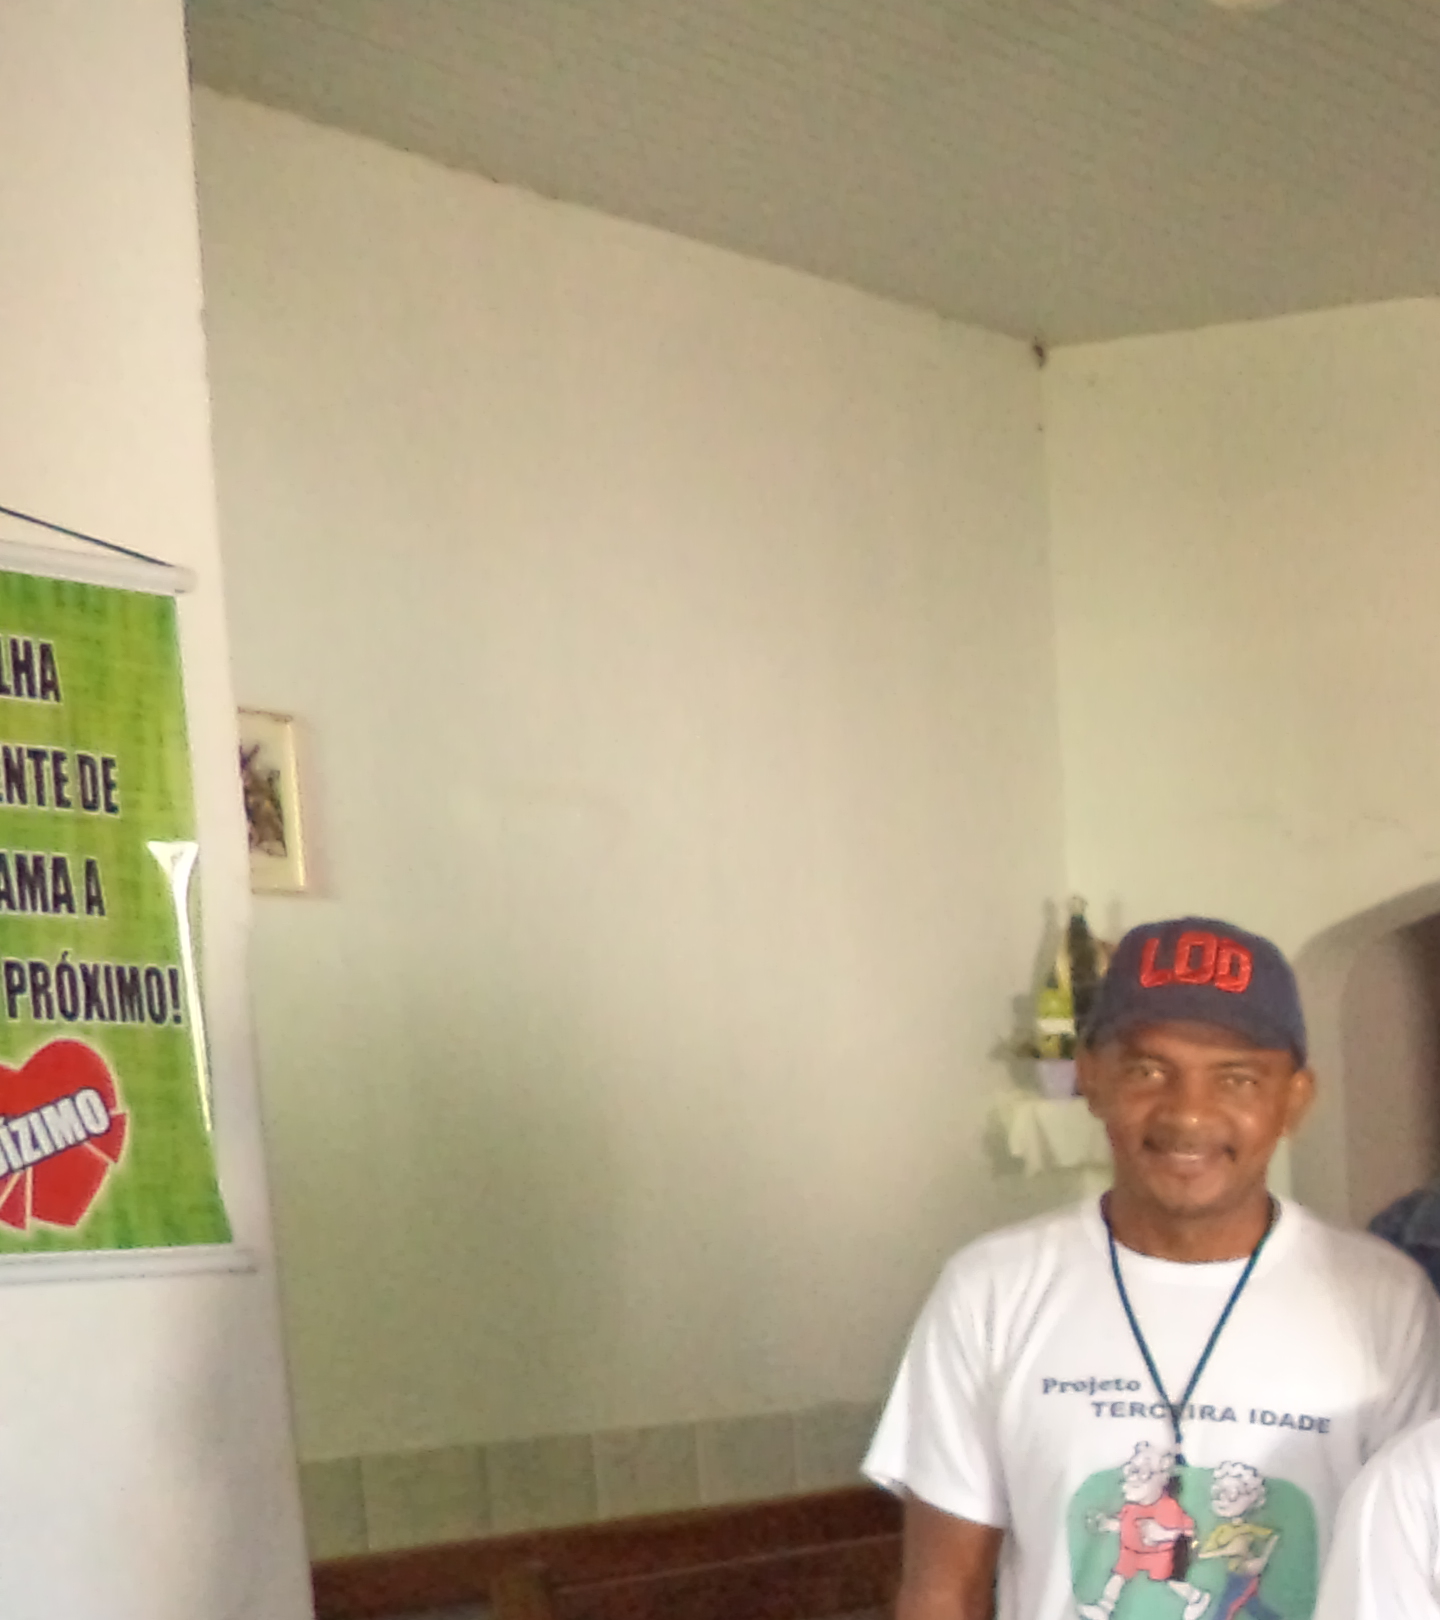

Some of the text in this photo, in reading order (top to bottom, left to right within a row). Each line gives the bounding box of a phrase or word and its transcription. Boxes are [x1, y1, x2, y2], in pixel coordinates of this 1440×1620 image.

[76, 752, 120, 815] DE
[84, 857, 107, 917] A
[3, 950, 183, 1026] PRÓXIMO!
[0, 1087, 110, 1175] ÍZIMO
[1042, 1376, 1142, 1397] Projeto
[1091, 1400, 1332, 1435] TERCIRA IDADE
